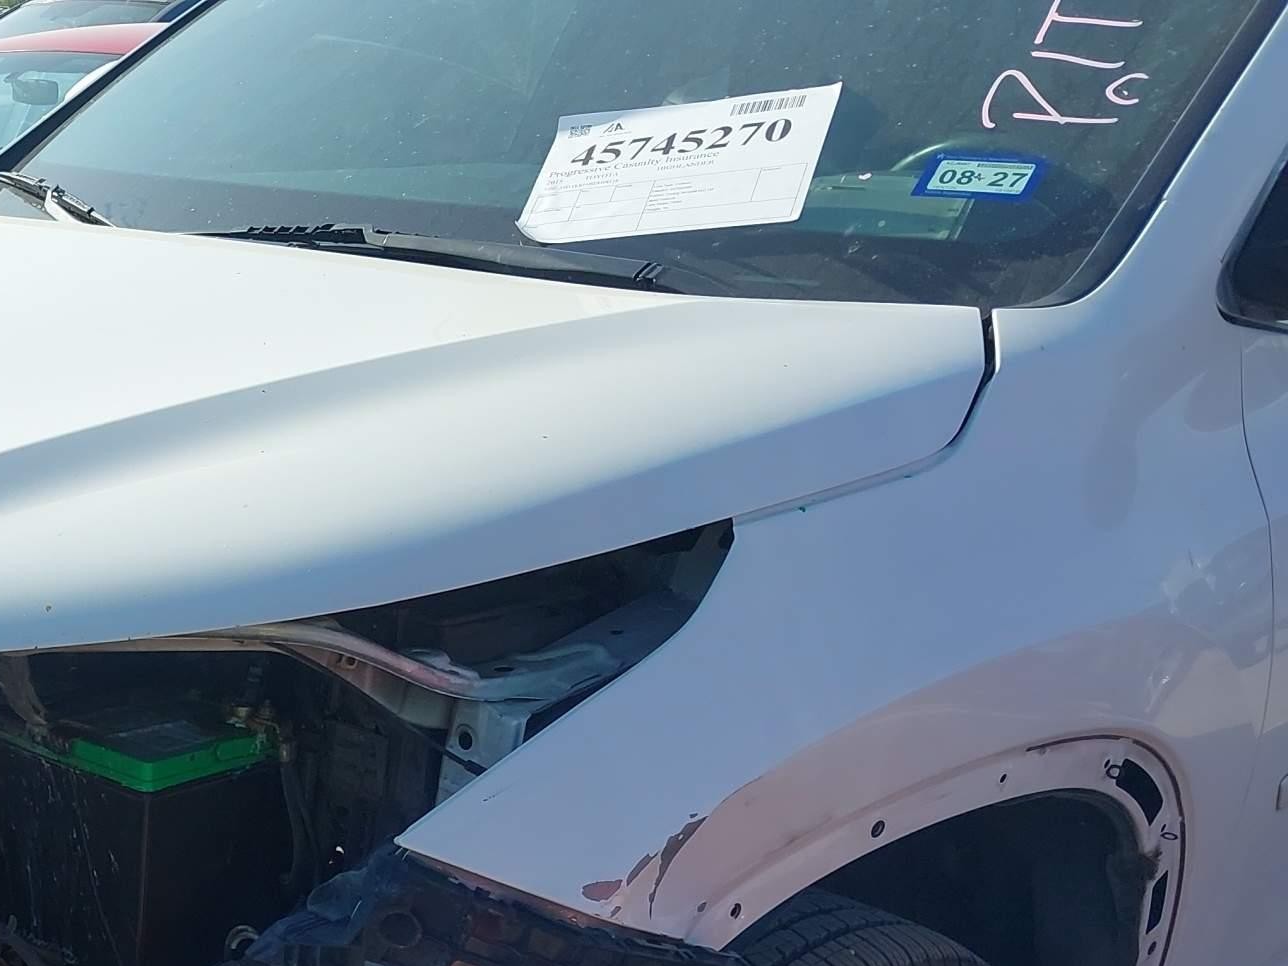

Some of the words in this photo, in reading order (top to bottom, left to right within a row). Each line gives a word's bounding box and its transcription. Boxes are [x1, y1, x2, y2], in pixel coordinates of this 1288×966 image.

[570, 117, 793, 167] 45745270
[548, 165, 614, 179] Progressive
[664, 150, 720, 163] Insurance
[938, 168, 975, 186] 08
[986, 172, 1029, 189] 27
